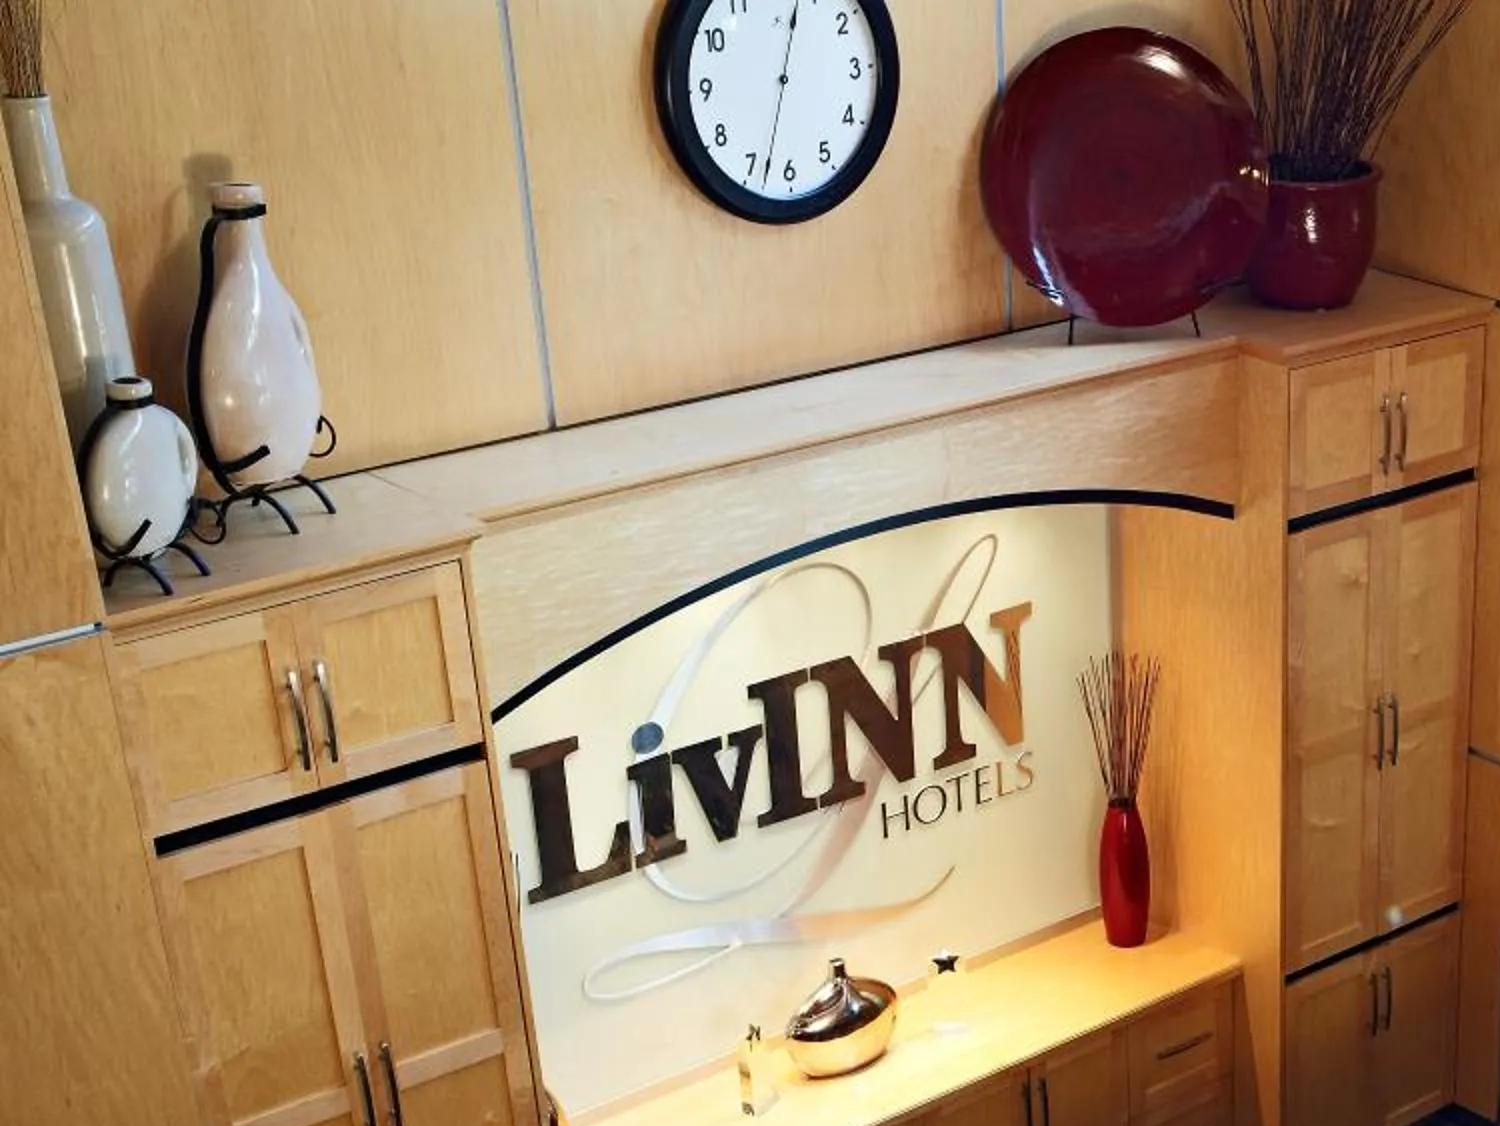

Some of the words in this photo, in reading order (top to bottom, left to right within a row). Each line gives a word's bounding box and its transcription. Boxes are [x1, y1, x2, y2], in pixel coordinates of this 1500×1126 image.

[836, 12, 849, 36] 2
[704, 28, 725, 52] 10
[849, 57, 861, 79] 3
[700, 78, 713, 102] 9
[842, 104, 855, 126] 4
[715, 124, 727, 146] 8
[819, 141, 831, 162] 5
[745, 153, 757, 176] 7
[783, 160, 796, 181] 6
[881, 751, 1034, 839] HOTELS
